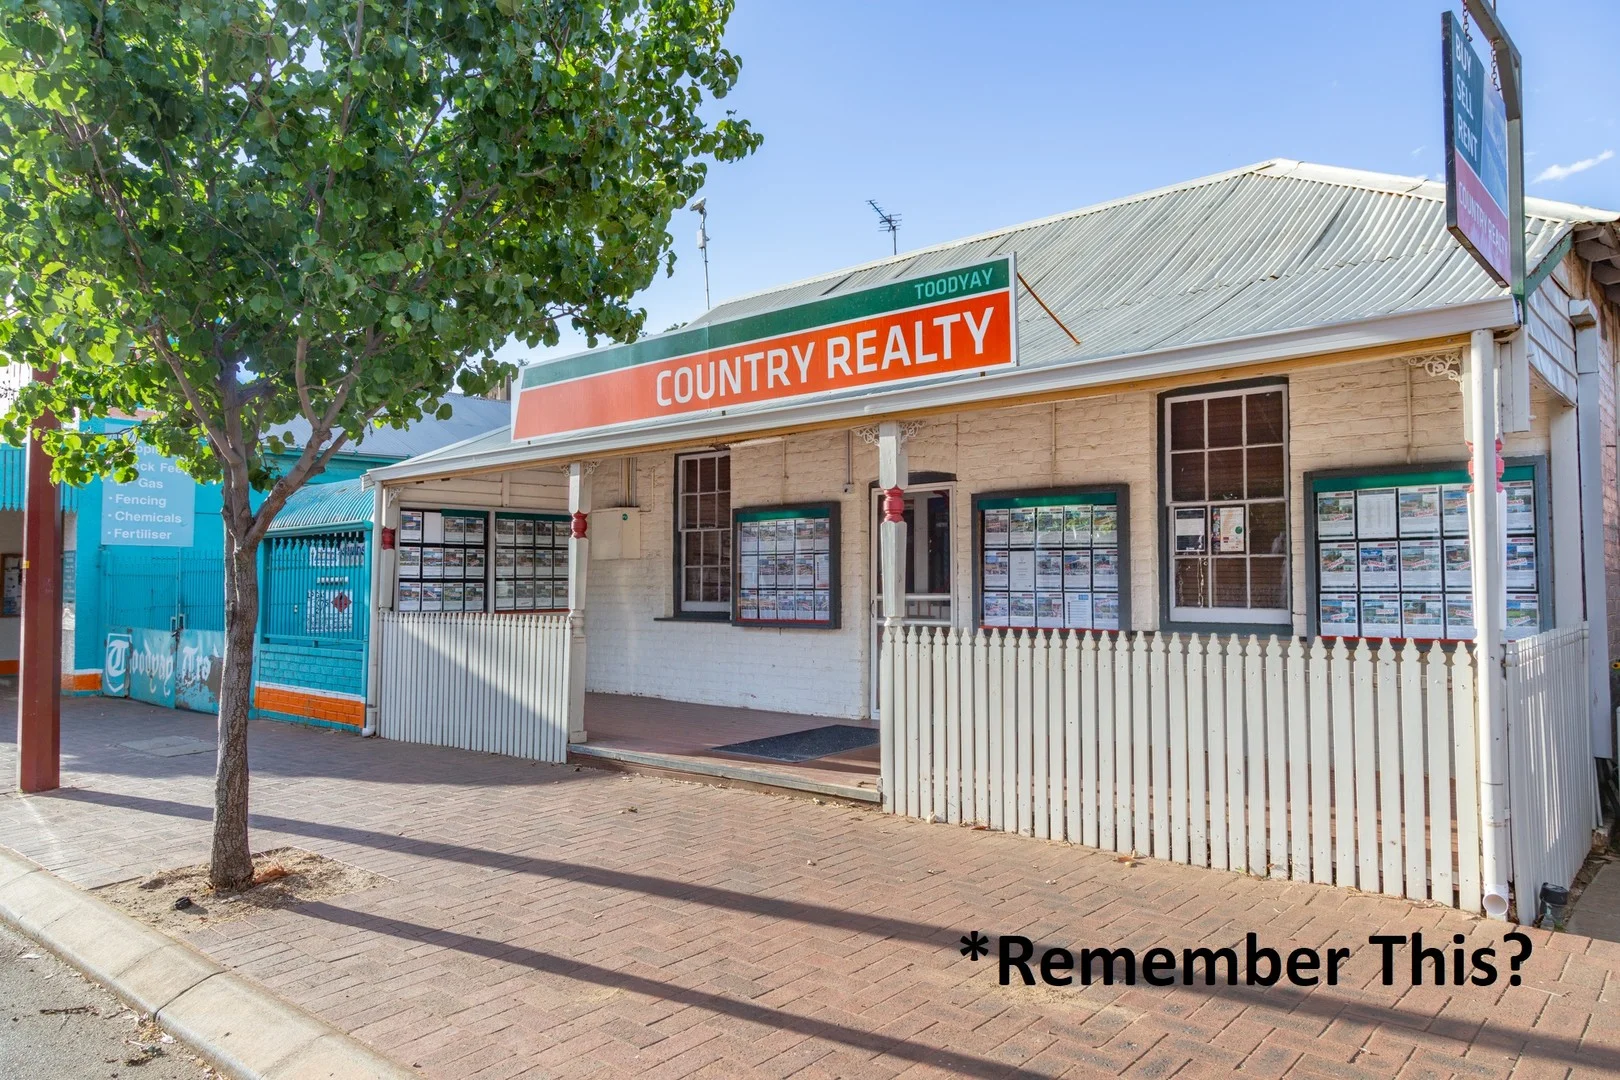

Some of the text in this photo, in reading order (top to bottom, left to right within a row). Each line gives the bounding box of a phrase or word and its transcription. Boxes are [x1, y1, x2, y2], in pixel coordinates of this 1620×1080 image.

[1455, 33, 1471, 78] BUY
[1456, 74, 1474, 120] SELL
[1457, 113, 1477, 162] RENT
[1459, 181, 1488, 235] COUNTRY
[914, 267, 993, 300] TOODYAY
[656, 306, 995, 407] COUNTRY REALTY
[115, 493, 167, 508] Fencing
[138, 477, 163, 489] Gas
[114, 528, 172, 540] Fertiliser
[115, 510, 182, 523] Chemicals
